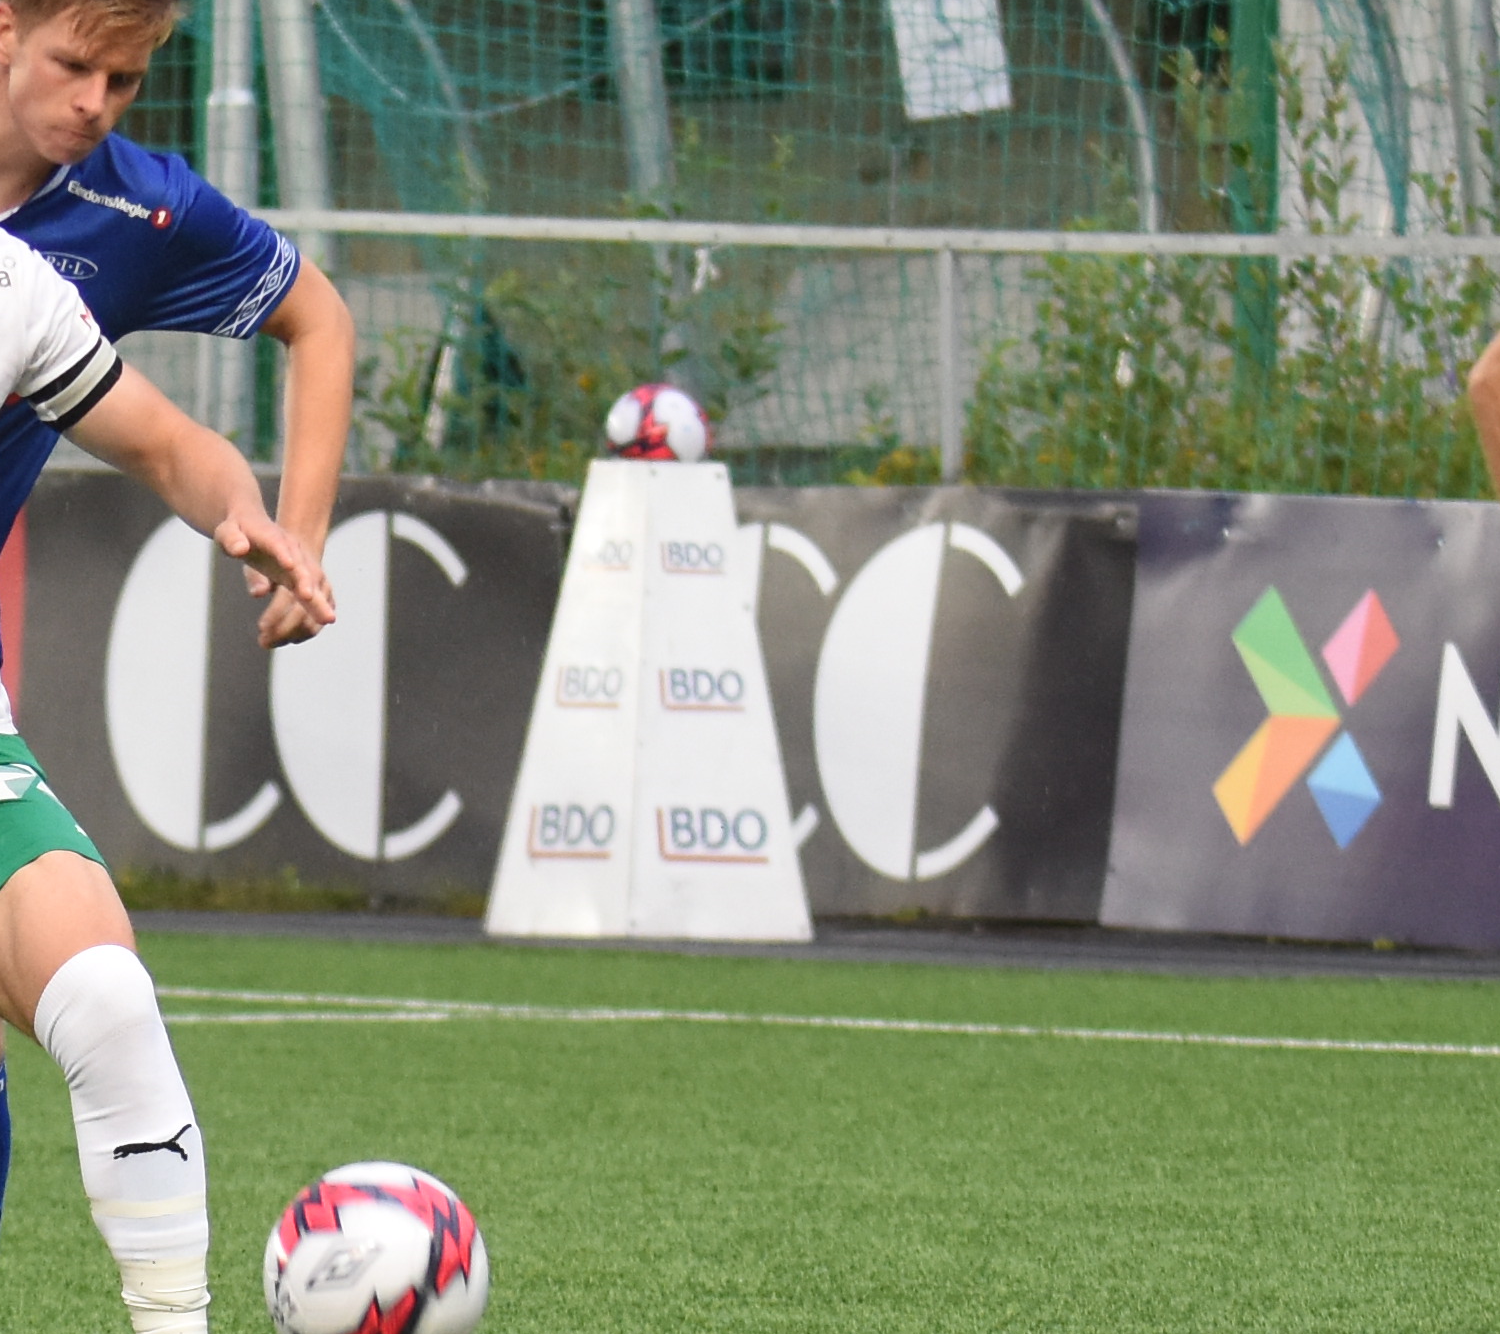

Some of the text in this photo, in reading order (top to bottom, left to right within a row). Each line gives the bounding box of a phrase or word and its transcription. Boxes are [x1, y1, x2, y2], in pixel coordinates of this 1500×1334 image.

[667, 541, 725, 567] BDO
[564, 666, 624, 699] BDO
[669, 668, 744, 702] BDO
[538, 804, 616, 847] BDO
[669, 807, 769, 852] BDO
